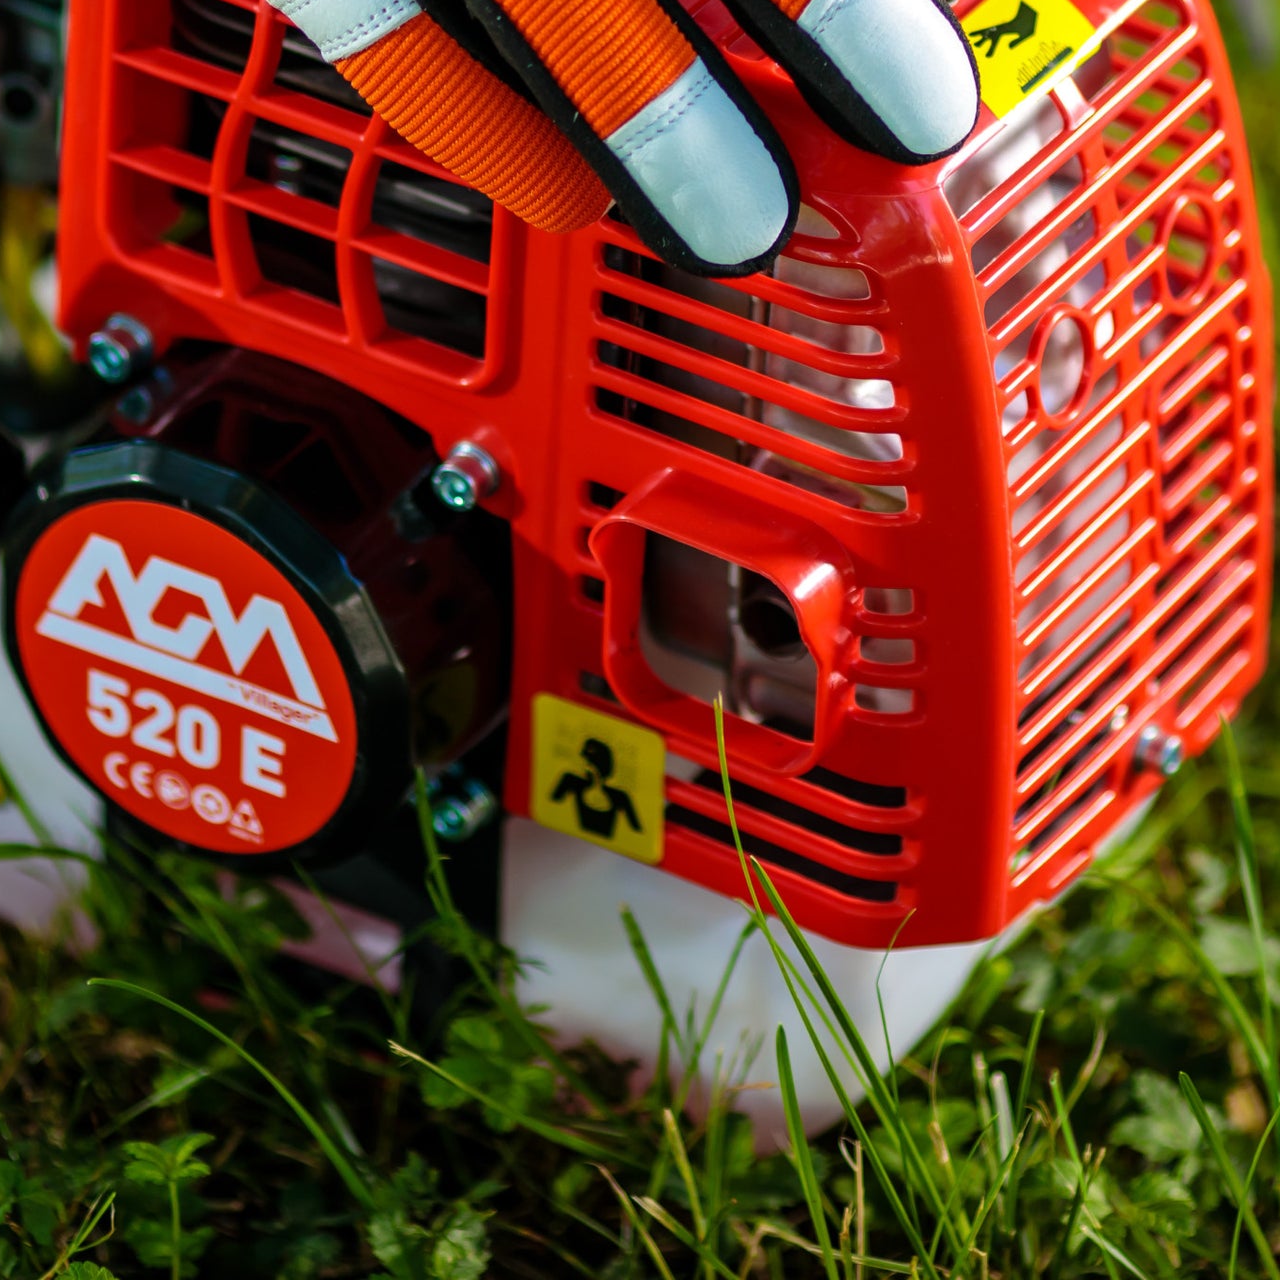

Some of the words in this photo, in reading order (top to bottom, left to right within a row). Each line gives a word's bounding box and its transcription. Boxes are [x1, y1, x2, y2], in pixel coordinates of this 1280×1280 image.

[47, 532, 327, 710] AGM
[86, 668, 221, 770] 520
[240, 724, 287, 799] E
